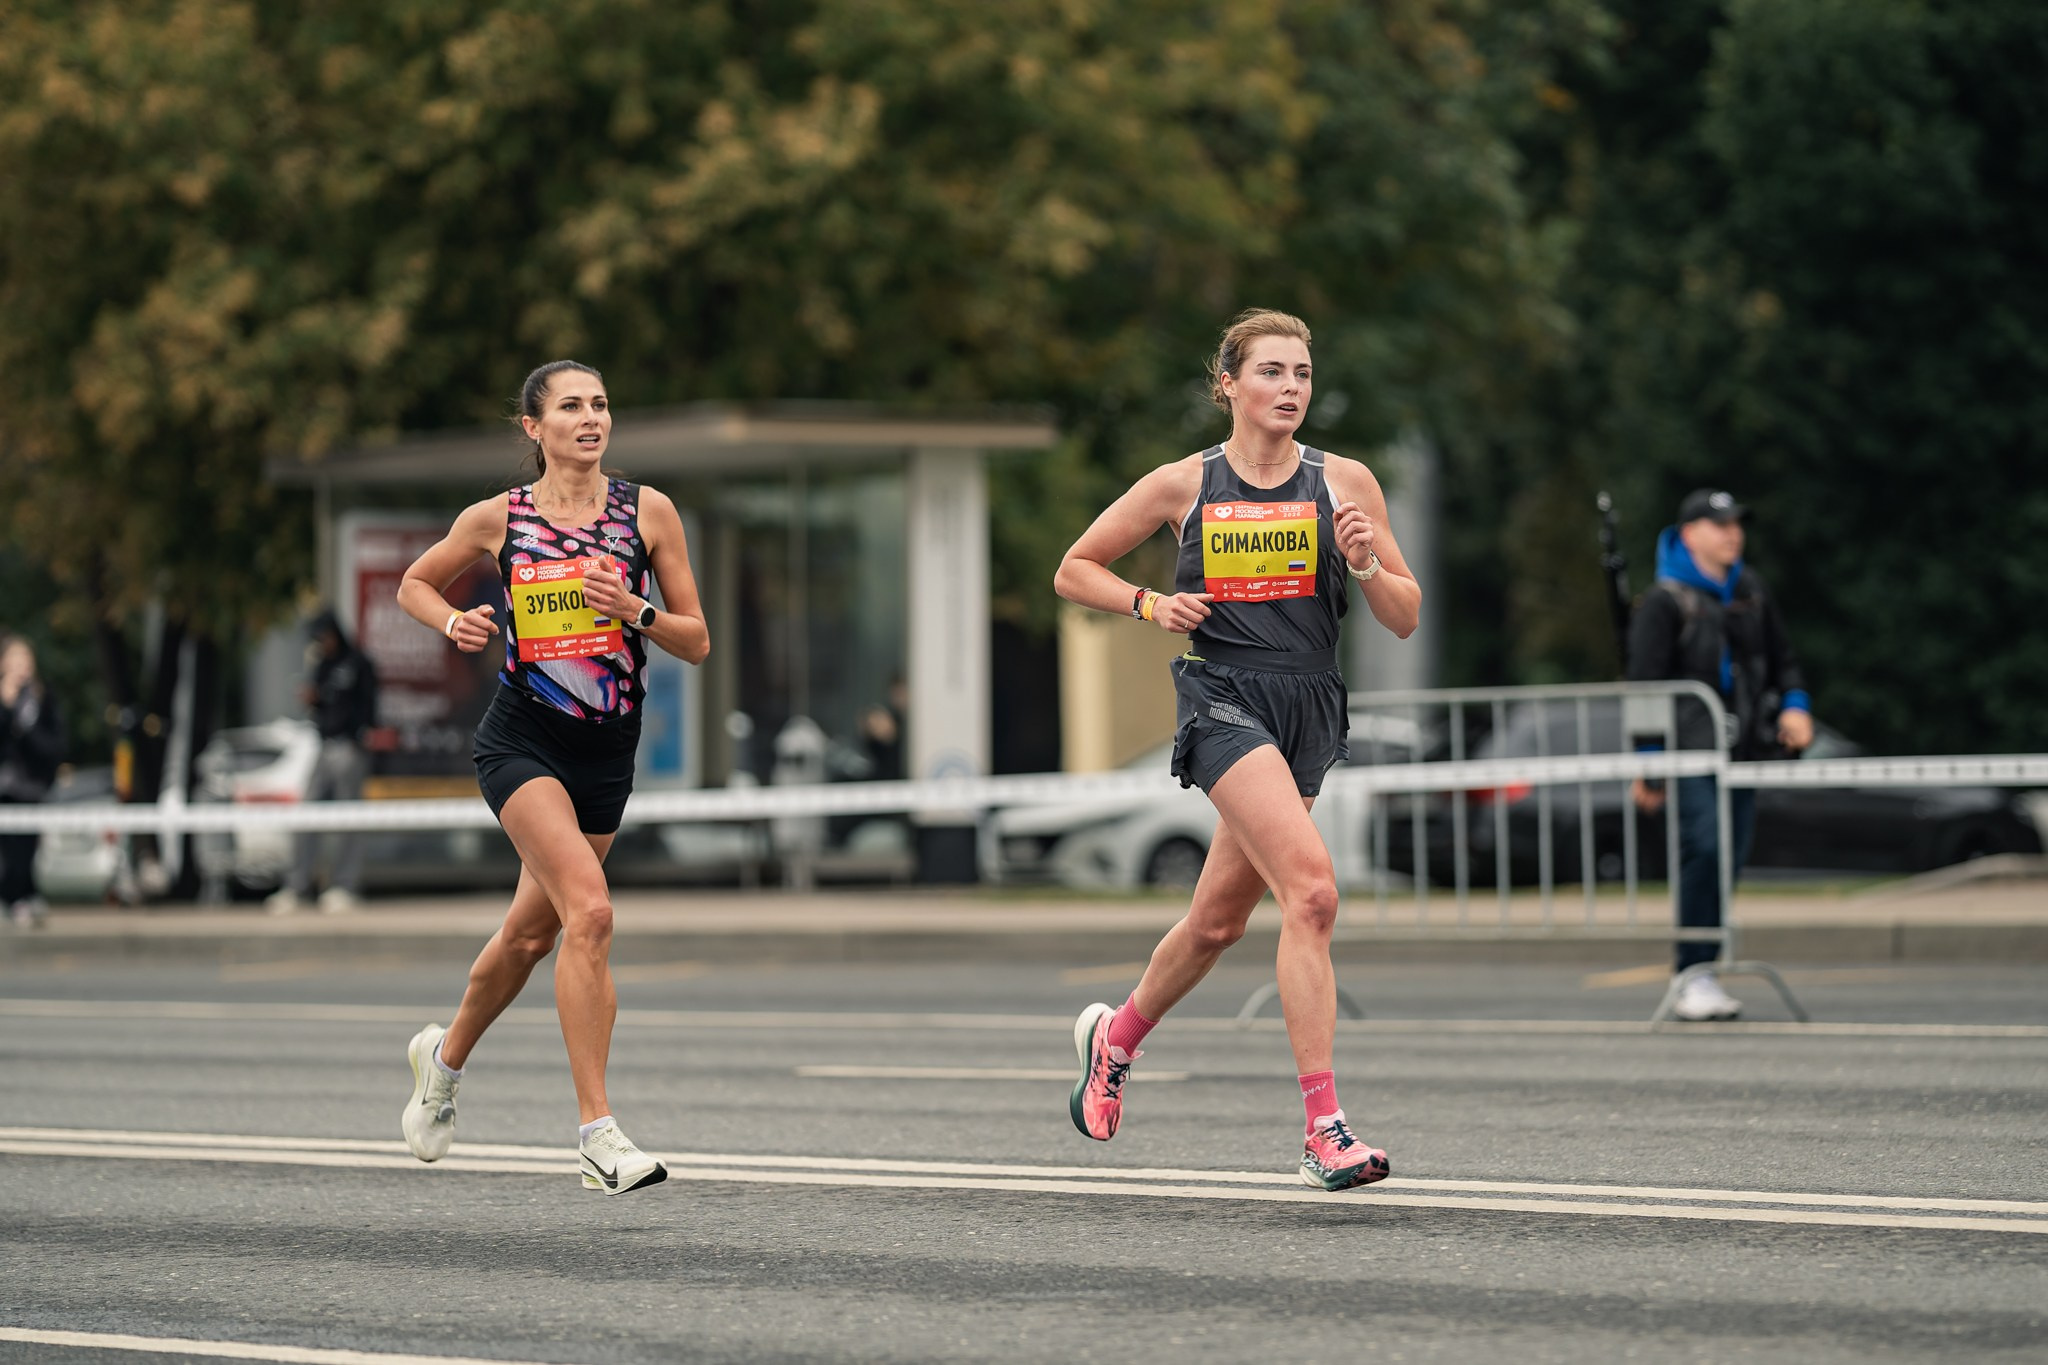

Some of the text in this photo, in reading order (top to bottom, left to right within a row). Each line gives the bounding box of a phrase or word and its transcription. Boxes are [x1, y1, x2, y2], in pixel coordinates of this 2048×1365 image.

[1211, 530, 1310, 554] СИМАКОВА
[537, 566, 576, 576] МОСКОВСКИЙ
[1256, 565, 1266, 573] 60
[562, 623, 573, 632] 59
